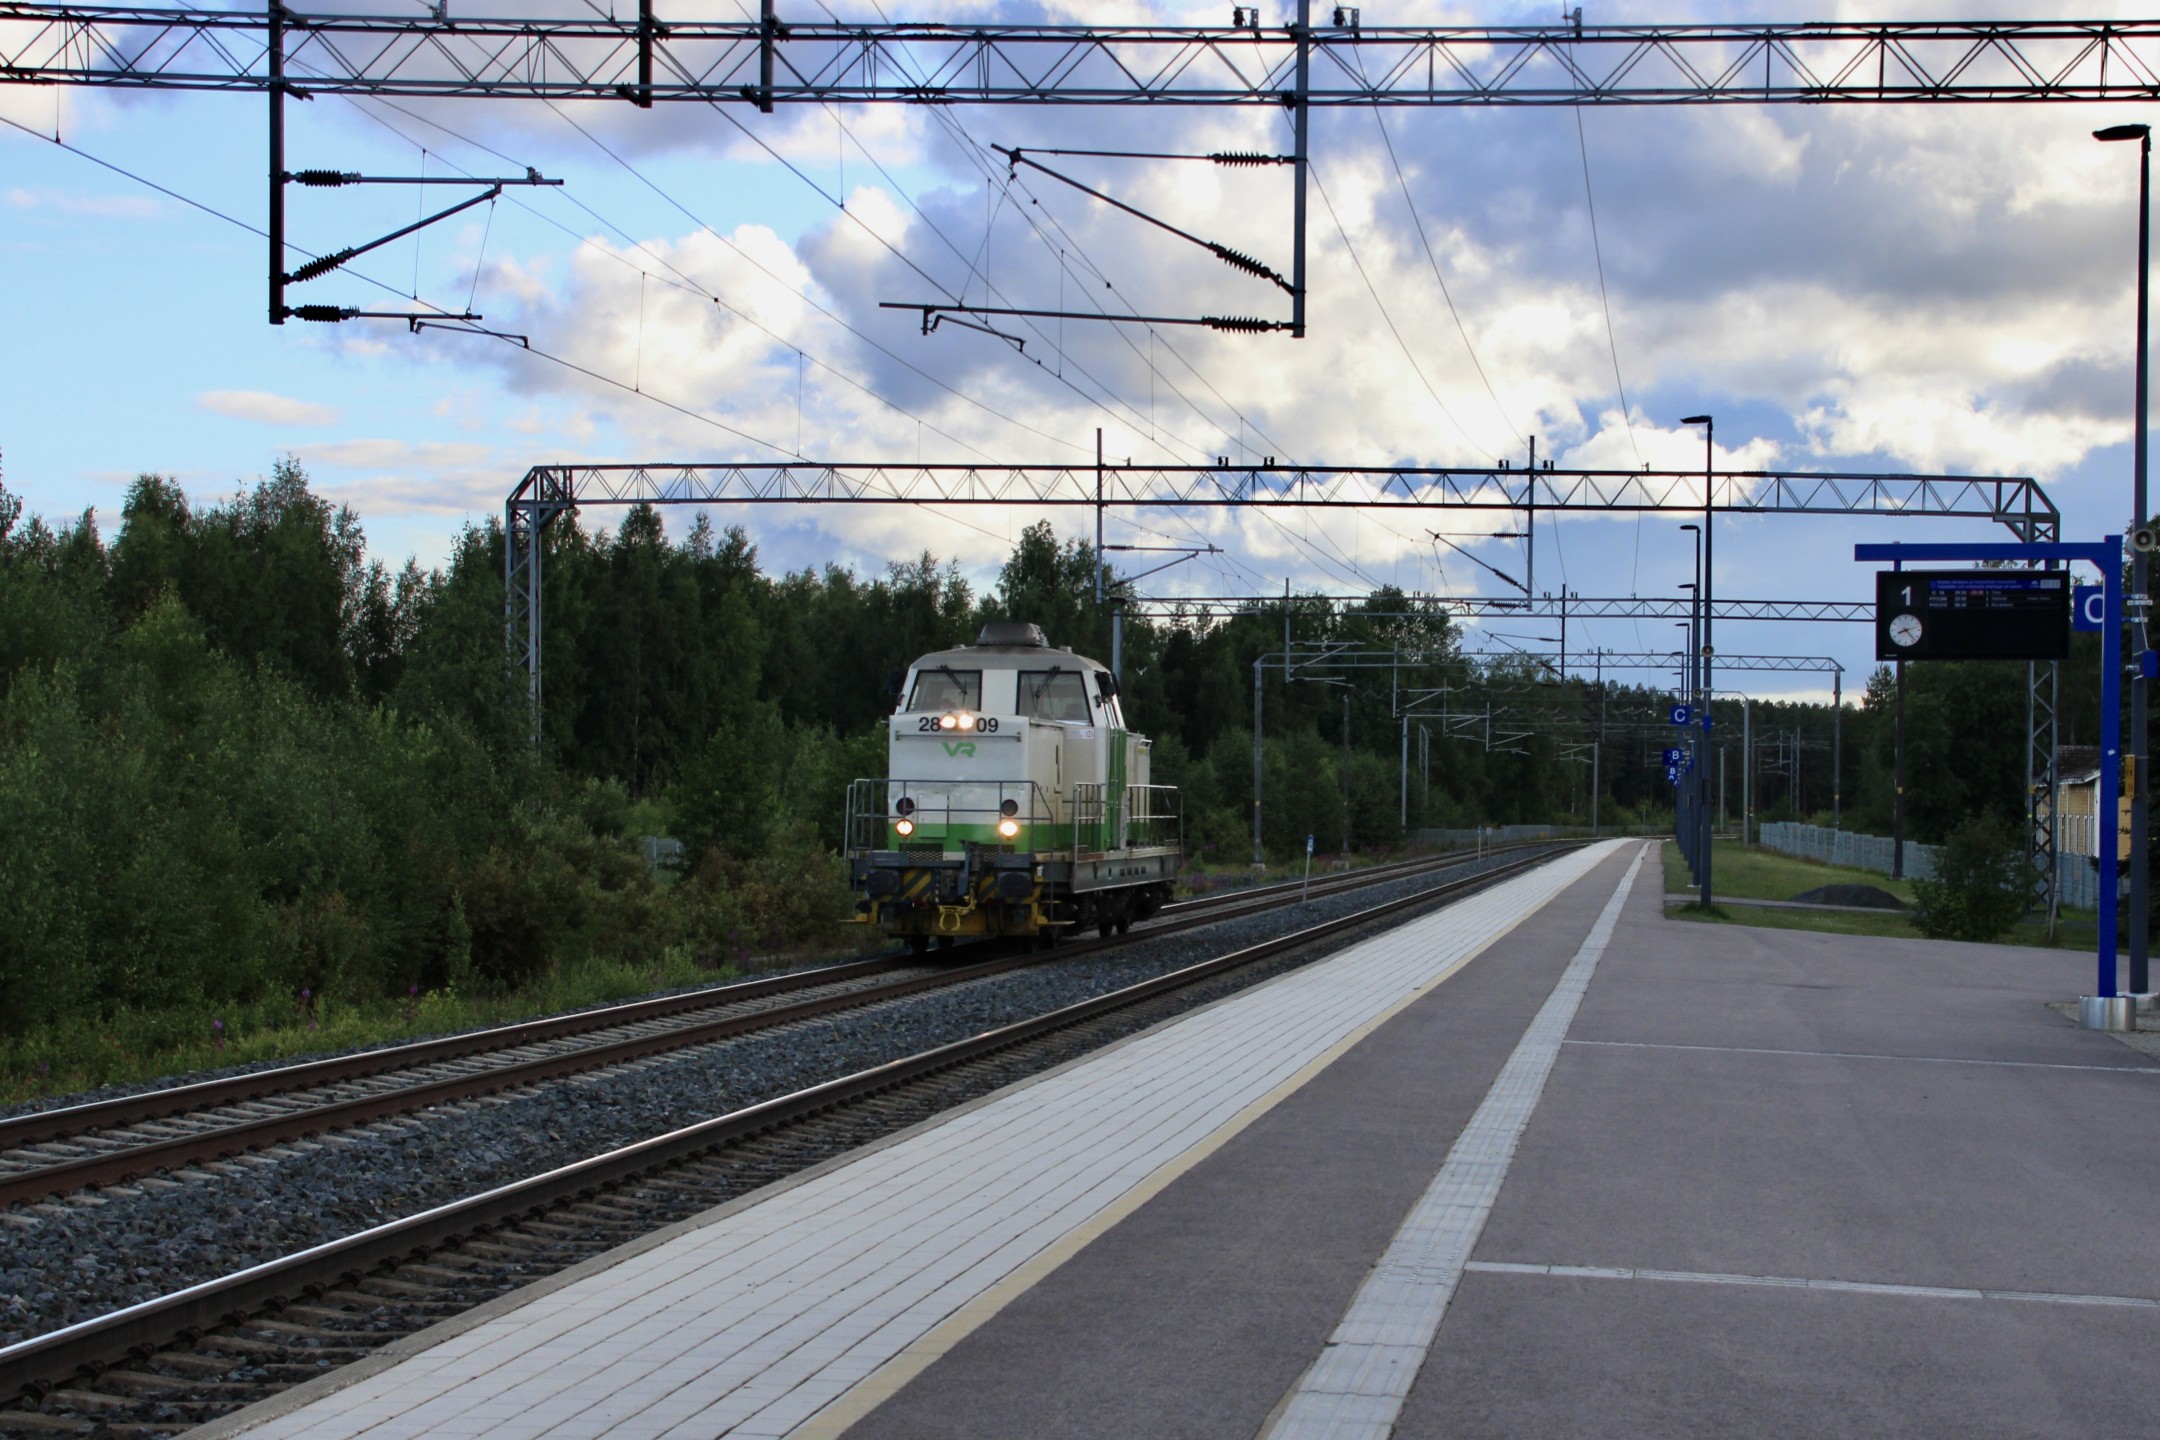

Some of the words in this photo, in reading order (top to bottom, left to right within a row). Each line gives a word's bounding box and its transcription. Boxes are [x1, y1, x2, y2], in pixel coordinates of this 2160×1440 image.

[1901, 586, 1911, 606] 1
[1674, 709, 1686, 722] C
[919, 716, 941, 732] 28
[977, 717, 999, 733] 09
[942, 742, 976, 757] VR
[1672, 751, 1679, 760] B
[1670, 767, 1675, 775] B
